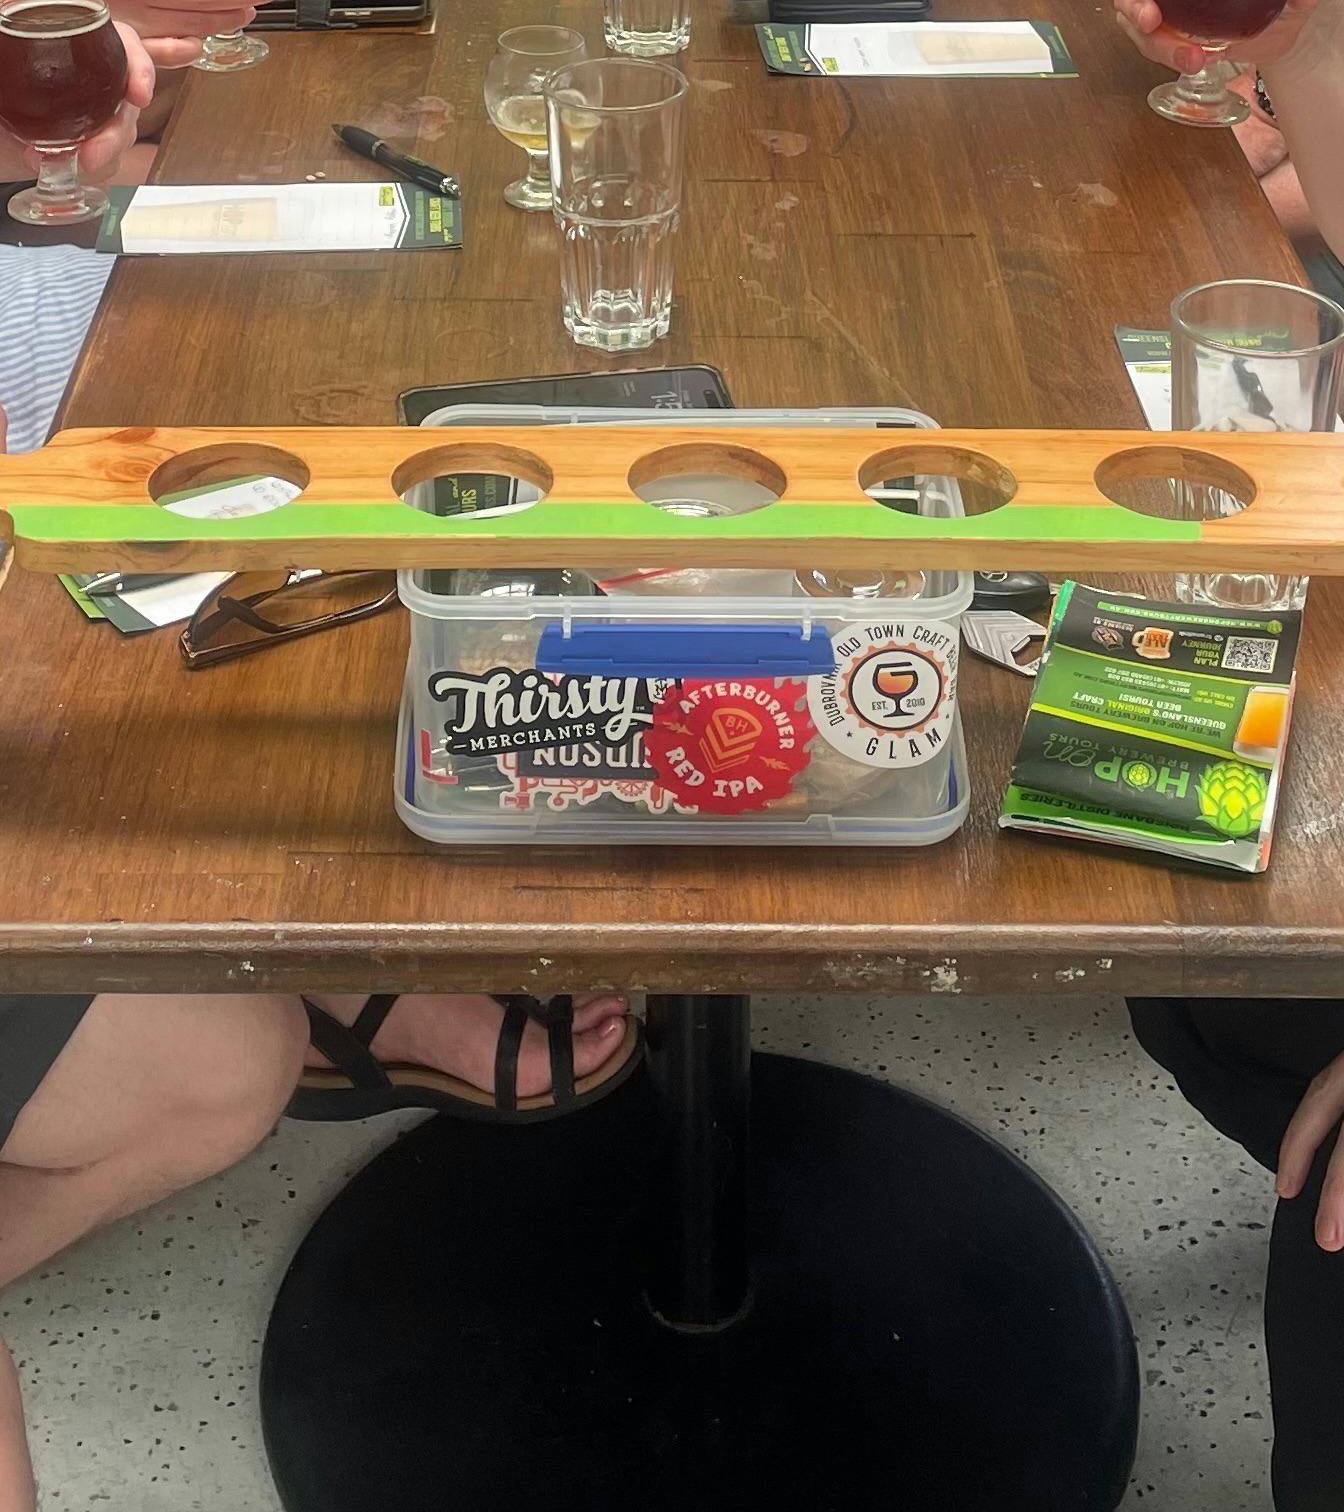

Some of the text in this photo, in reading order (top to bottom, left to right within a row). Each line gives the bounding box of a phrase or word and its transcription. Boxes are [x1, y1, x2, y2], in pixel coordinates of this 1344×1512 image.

[836, 637, 862, 658] OLD
[864, 624, 905, 641] TOWN
[912, 625, 950, 651] CRAFT
[1195, 649, 1220, 658] YOUR
[1193, 656, 1218, 667] PLAN
[435, 671, 655, 742] Thirsty
[1072, 691, 1105, 705] CRAFT
[1156, 700, 1182, 712] BEER
[679, 681, 795, 750] AFTERBURNER
[469, 722, 597, 753] MERCHANTS
[865, 727, 942, 760] GLAM
[1049, 732, 1189, 770] BREWERY TOURS
[665, 746, 764, 798] RED IPA
[1093, 755, 1190, 799] HOP
